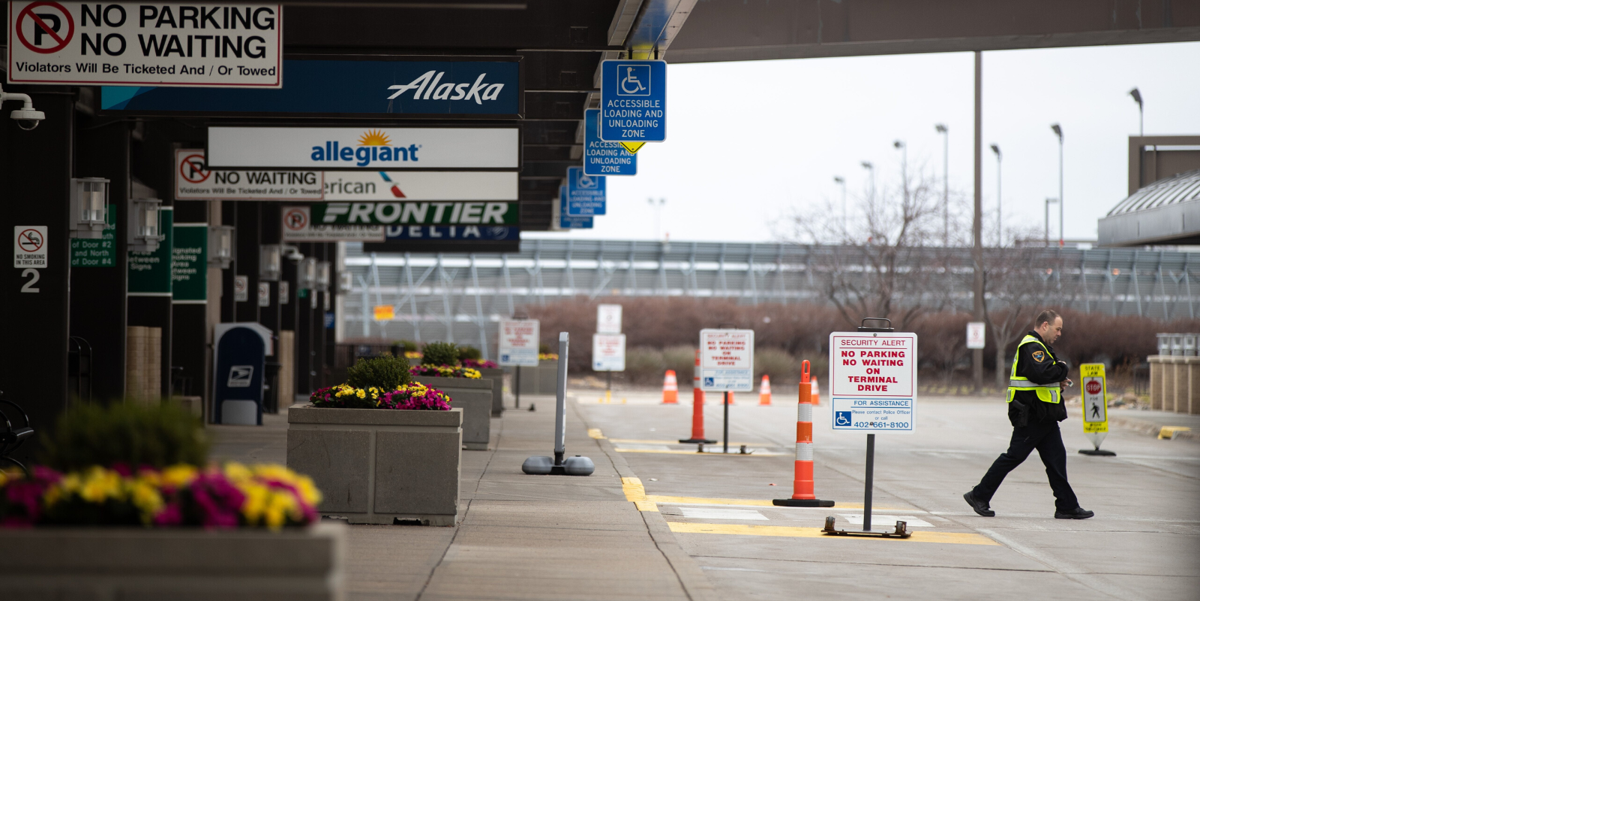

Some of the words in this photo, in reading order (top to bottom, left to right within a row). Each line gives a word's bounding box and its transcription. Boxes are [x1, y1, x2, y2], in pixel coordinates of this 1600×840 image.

[81, 4, 127, 27] NO
[139, 5, 275, 30] PARKING
[81, 33, 127, 57] NO
[138, 34, 266, 59] WAITING
[16, 62, 71, 73] Violators
[76, 62, 97, 73] Will
[103, 63, 119, 74] Be
[123, 63, 175, 75] Ticketed
[180, 64, 205, 75] And
[218, 65, 233, 76] Or
[237, 65, 275, 76] Towed
[387, 70, 504, 105] Alaska
[607, 100, 660, 108] ACCESSIBLE
[604, 110, 642, 118] LOADING
[645, 110, 663, 118] AND
[609, 120, 658, 128] UNLOADING
[622, 130, 645, 138] ZONE
[590, 157, 631, 165] UNLOADING
[215, 172, 240, 185] NO
[246, 172, 317, 185] WAITING
[238, 187, 267, 195] Ticketed
[269, 187, 283, 195] And
[322, 202, 508, 223] FRONTIER
[386, 225, 481, 238] DELTA
[20, 268, 41, 293] 2
